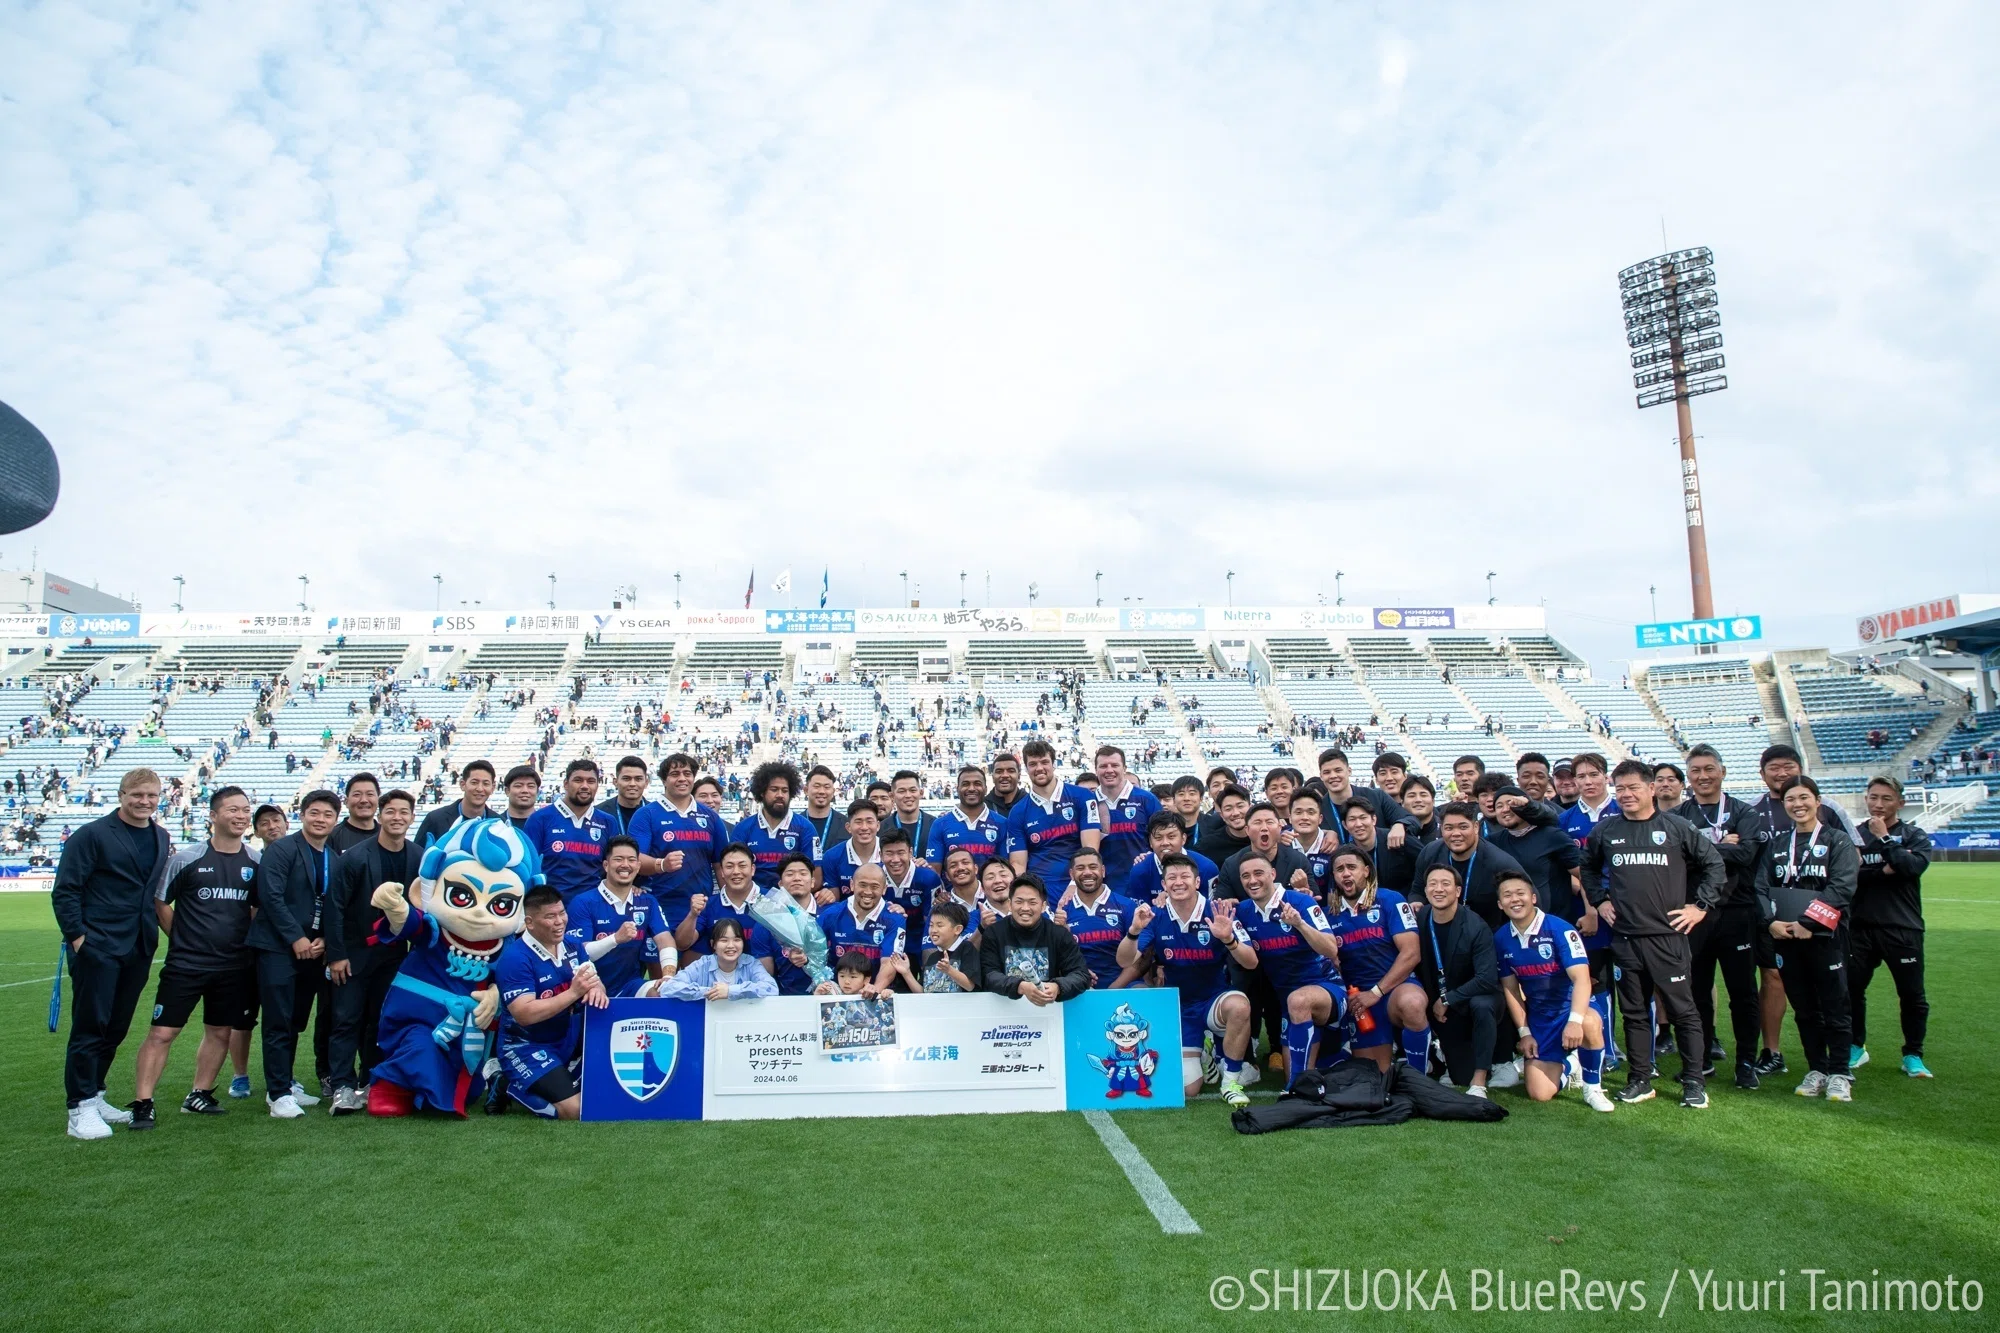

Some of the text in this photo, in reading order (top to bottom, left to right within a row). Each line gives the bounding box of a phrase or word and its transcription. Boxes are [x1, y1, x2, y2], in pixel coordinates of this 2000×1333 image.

[1682, 458, 1702, 528] 静岡新聞
[875, 613, 938, 623] SAKURA
[943, 608, 982, 625] 地元で
[1223, 610, 1272, 621] Niterra
[1877, 599, 1957, 639] YAMAHA
[342, 616, 401, 631] 静岡新聞
[446, 616, 476, 631] SBS
[520, 615, 580, 631] 静岡新聞
[638, 619, 671, 628] GEAR
[1670, 621, 1726, 643] NTN
[674, 831, 711, 842] YAMAHA
[564, 841, 601, 855] YAMAHA
[1622, 852, 1668, 867] YAMAHA
[212, 887, 249, 901] YAMAHA
[1813, 904, 1838, 921] STAFF
[1078, 930, 1122, 943] YAMAHA
[1342, 926, 1384, 944] YAMAHA
[1173, 948, 1214, 961] YAMAHA
[620, 1025, 670, 1033] BlueRevs
[848, 1028, 869, 1043] 150
[980, 1027, 1043, 1041] BlueRevs
[734, 1032, 818, 1043] セキスイハイム東海
[749, 1045, 803, 1058] presents
[749, 1059, 803, 1071] マッチデー
[981, 1063, 1045, 1073] 三重ホンダヒート
[753, 1075, 798, 1083] 2024.04.06
